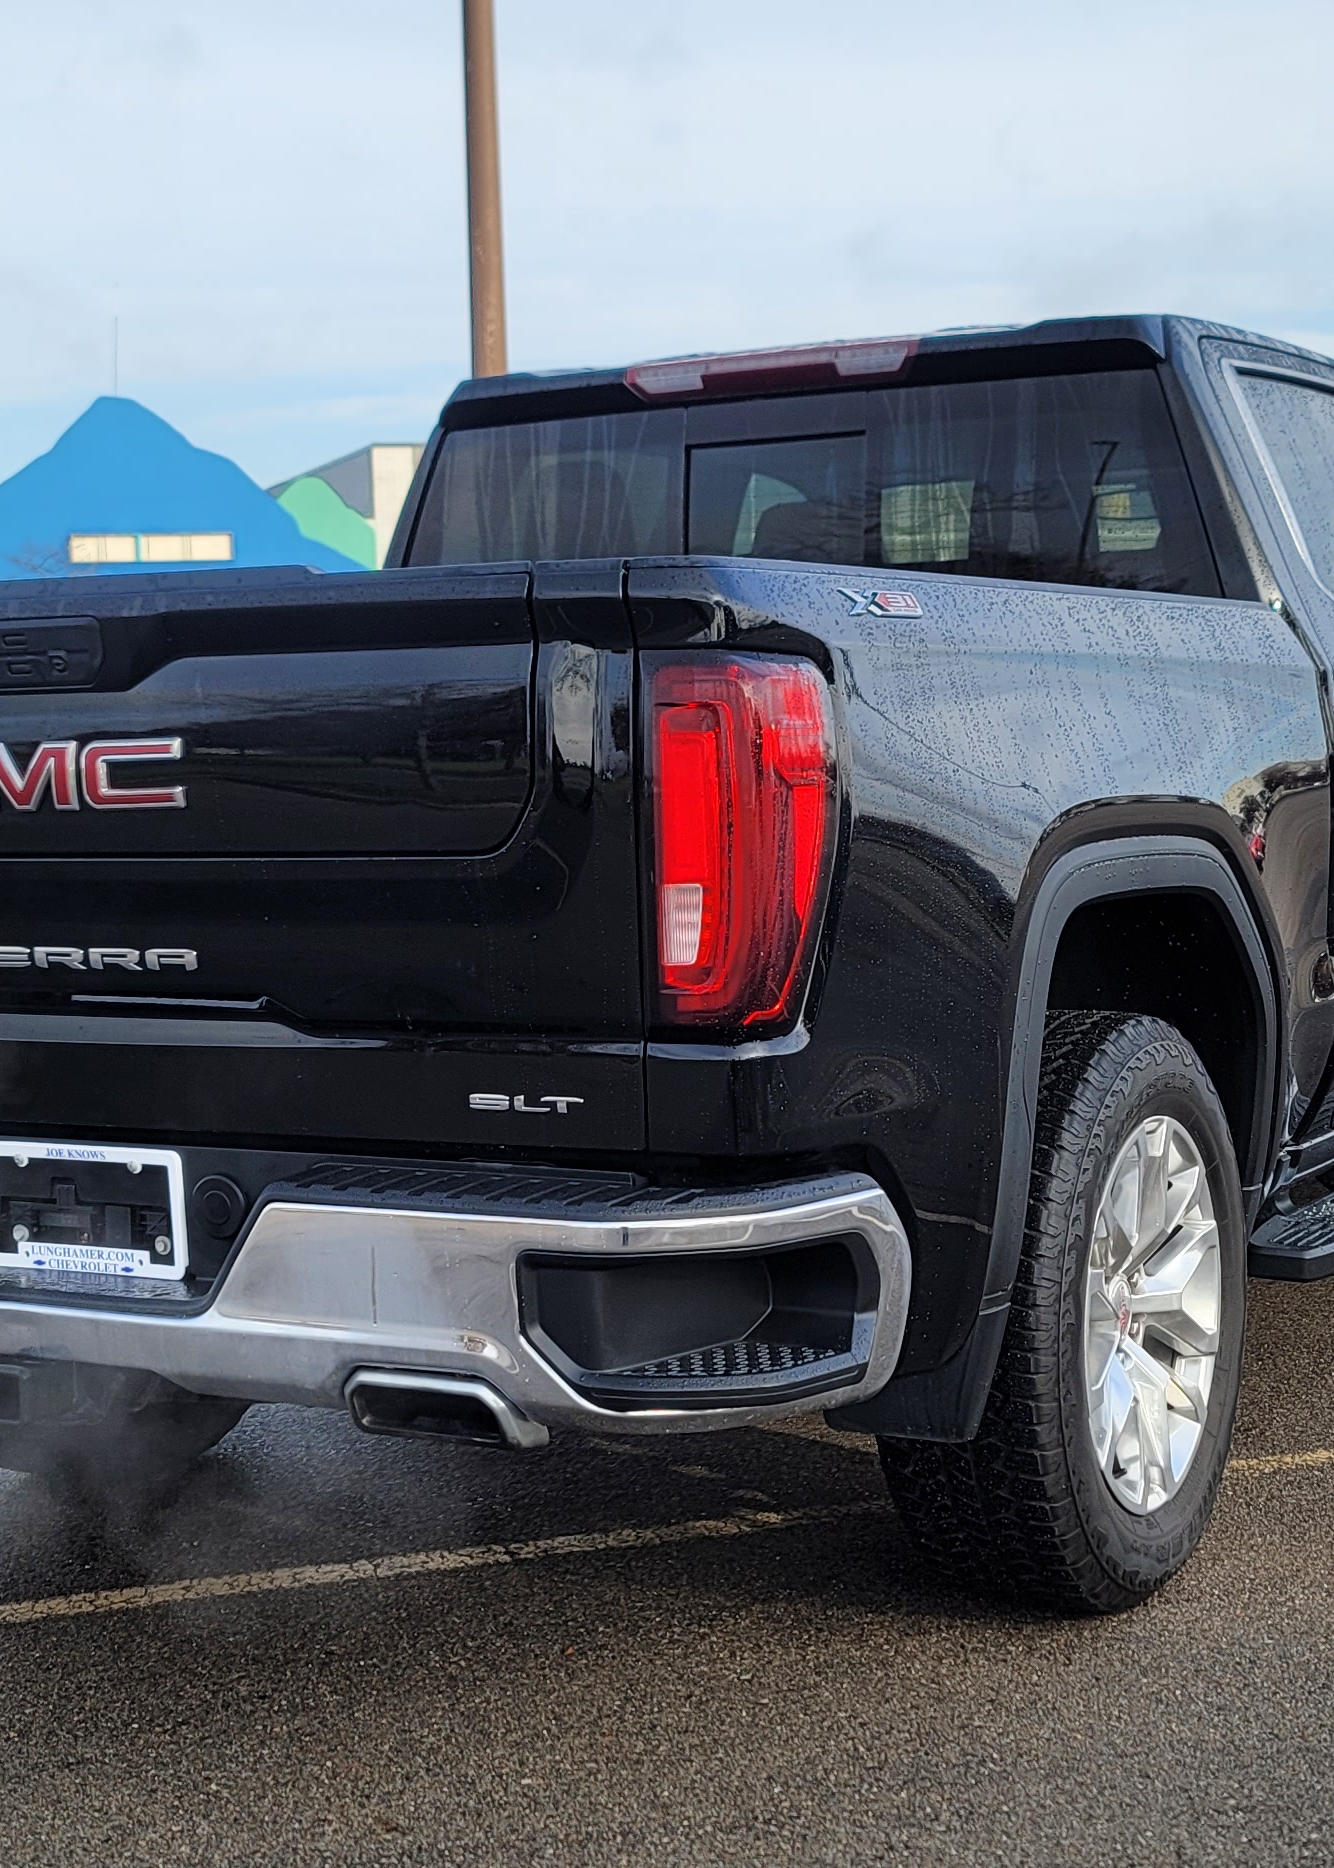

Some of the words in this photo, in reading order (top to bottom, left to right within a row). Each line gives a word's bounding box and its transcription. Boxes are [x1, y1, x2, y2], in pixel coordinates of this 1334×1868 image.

[469, 1093, 584, 1114] SLT
[46, 1147, 65, 1158] JOE
[67, 1149, 106, 1160] KNOWS
[31, 1245, 135, 1263] LUNGHAMER.COM
[48, 1258, 119, 1274] CHEVROLET
